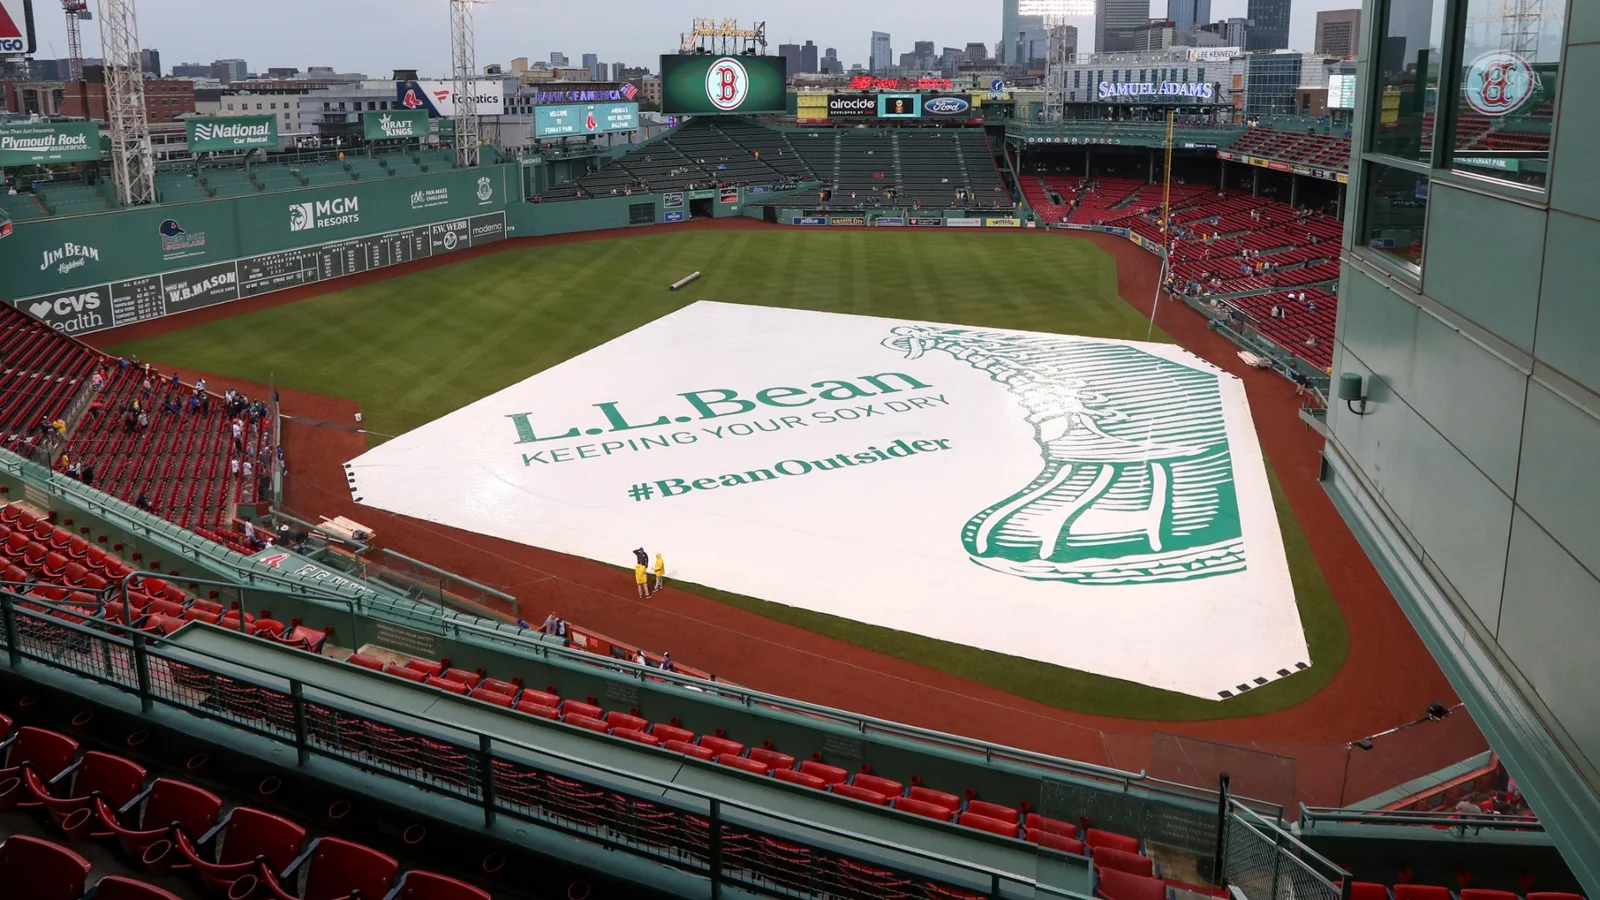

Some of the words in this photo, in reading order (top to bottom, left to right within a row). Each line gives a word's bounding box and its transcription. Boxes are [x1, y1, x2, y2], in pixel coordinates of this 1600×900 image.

[1197, 50, 1209, 59] LEE
[1209, 49, 1238, 58] KENNEDY
[716, 65, 740, 103] B
[1099, 81, 1157, 99] SAMUEL
[1158, 80, 1213, 98] ADAMS
[830, 98, 875, 109] airocide
[932, 98, 960, 112] Ford
[211, 122, 268, 138] National
[381, 119, 413, 130] DRAFT
[386, 127, 413, 136] KINGS
[1, 134, 56, 149] Plymouth
[58, 133, 87, 145] Rock
[233, 137, 246, 145] Car
[246, 136, 268, 144] Rental
[316, 196, 359, 217] MGM
[317, 213, 360, 229] RESORTS
[446, 221, 467, 231] WEBB
[472, 223, 502, 235] moderna
[40, 247, 63, 271] JIM
[64, 242, 100, 262] BEAM
[53, 291, 101, 316] CVS
[504, 368, 933, 445] L.L.Bean
[521, 430, 697, 467] KEEPING
[702, 413, 809, 440] YOUR
[811, 404, 886, 425] SOX
[884, 393, 951, 413] DRY
[627, 435, 953, 502] #BeanOutsider
